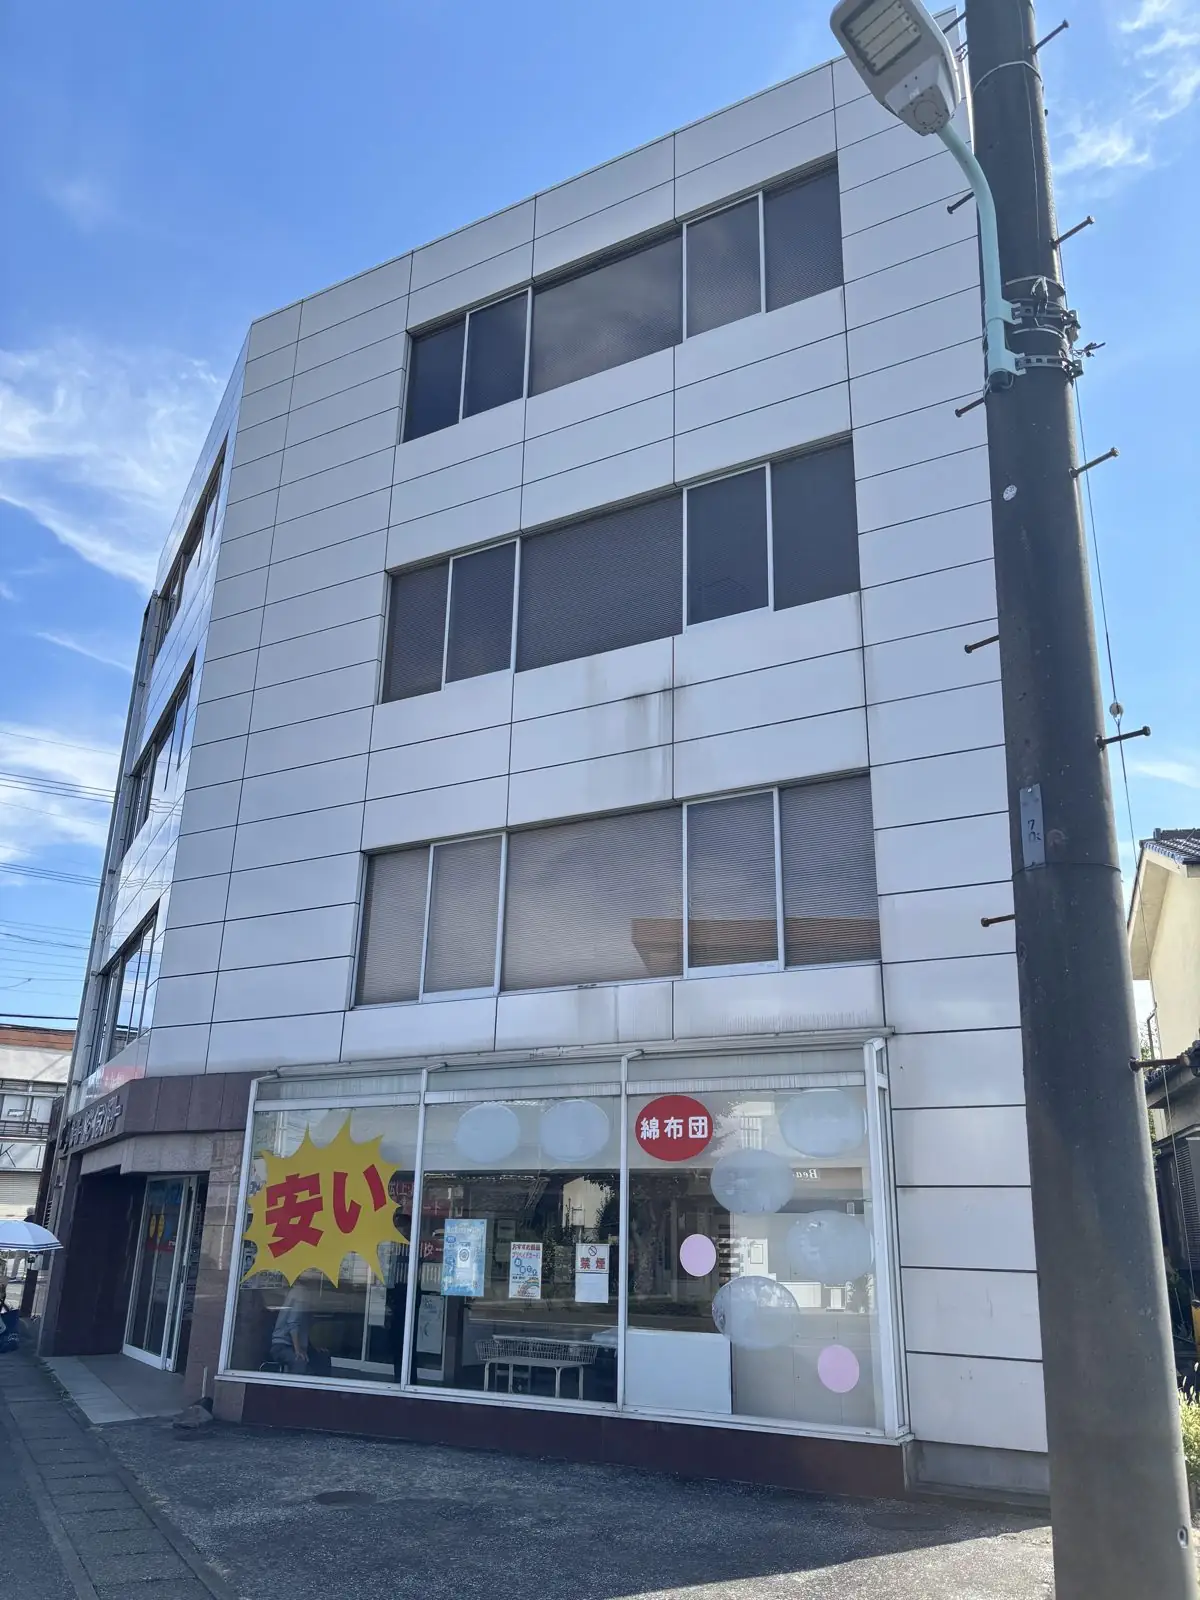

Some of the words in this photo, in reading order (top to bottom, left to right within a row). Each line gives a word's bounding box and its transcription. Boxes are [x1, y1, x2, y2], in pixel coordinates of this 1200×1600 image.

[640, 1116, 708, 1140] 綿布団
[265, 1163, 387, 1259] 安い
[579, 1256, 606, 1270] 禁煙
